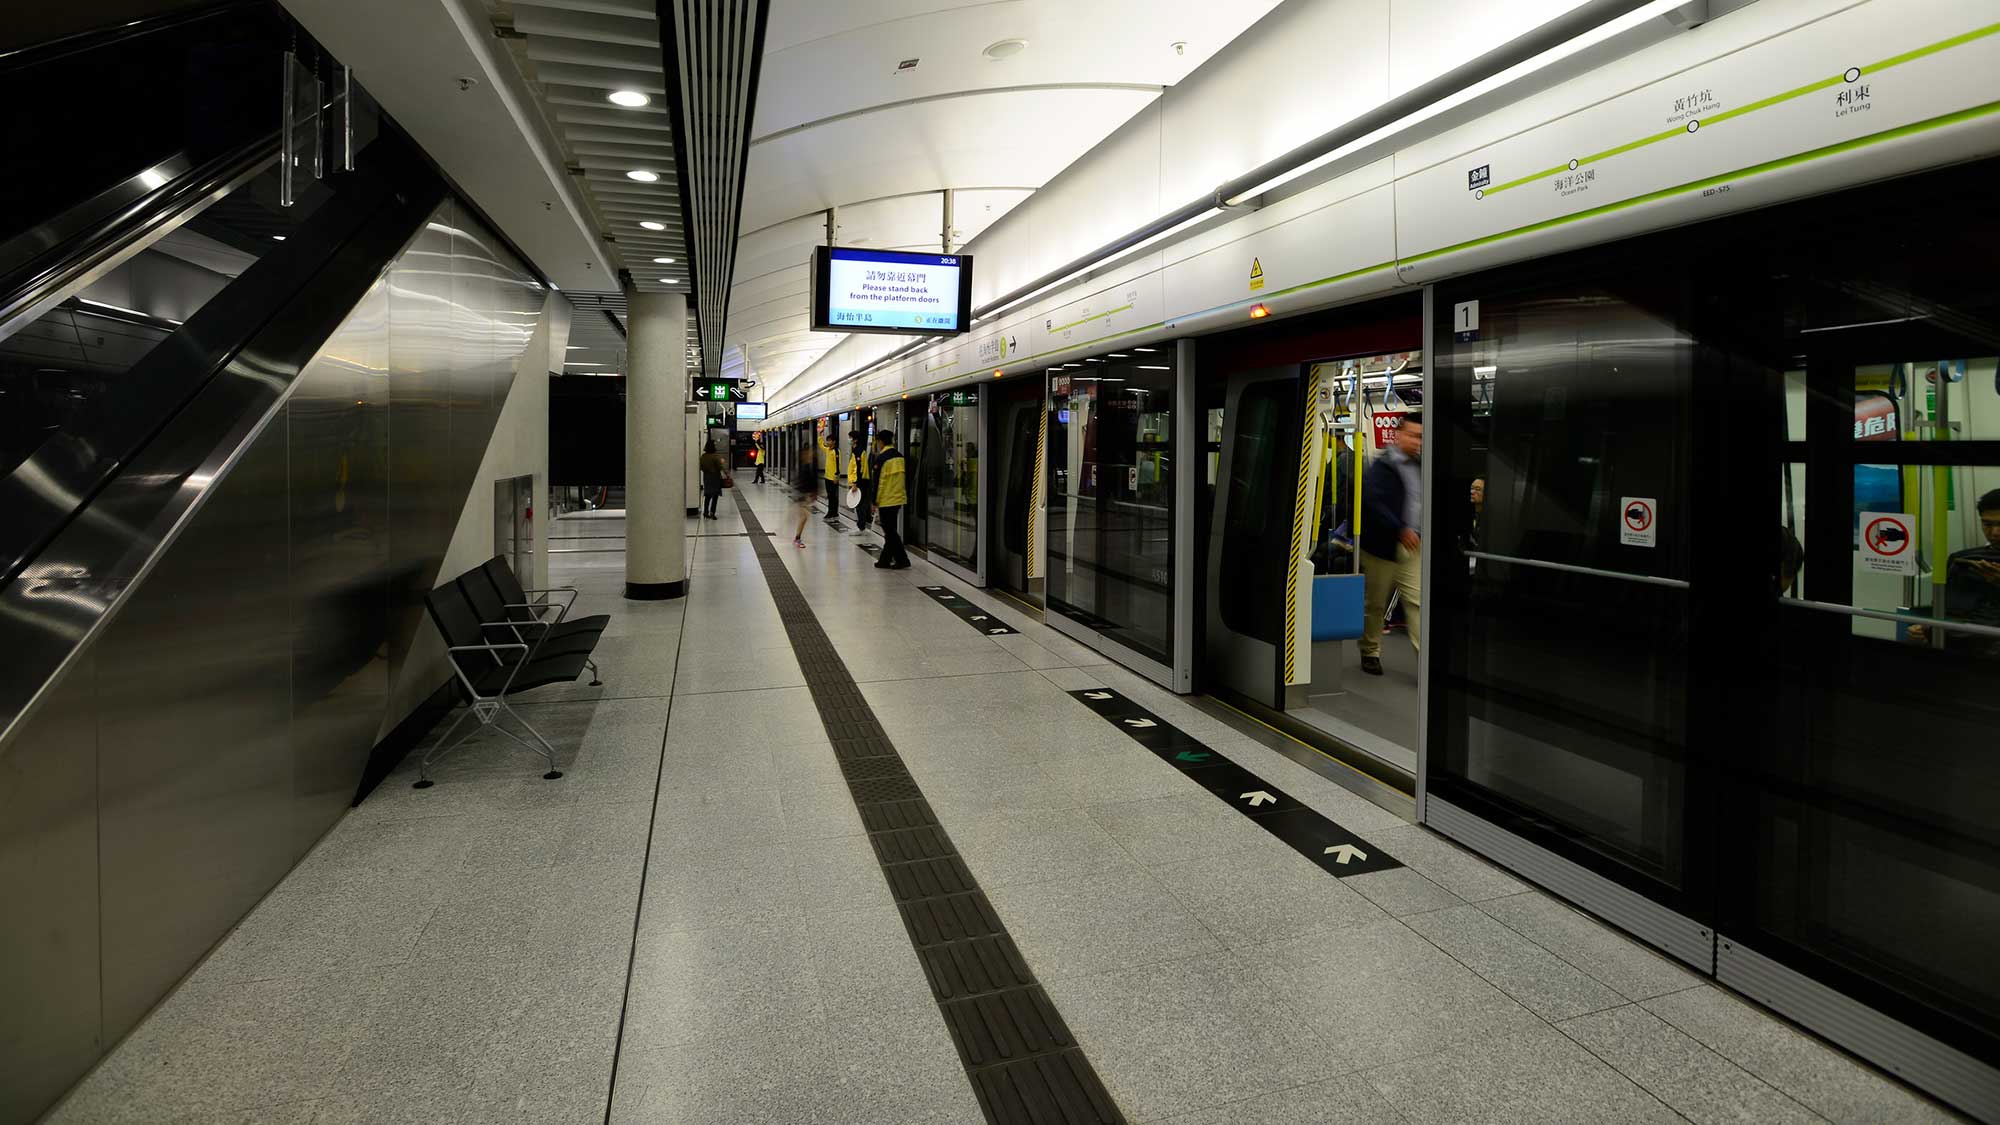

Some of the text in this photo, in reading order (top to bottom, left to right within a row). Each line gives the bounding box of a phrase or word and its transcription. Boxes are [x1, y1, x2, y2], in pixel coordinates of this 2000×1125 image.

[1673, 89, 1712, 112] 黃竹坑
[1836, 85, 1870, 107] 利東
[1666, 101, 1721, 125] Wong Chuk Hang
[1835, 101, 1871, 118] Lei Tung
[1554, 170, 1594, 191] 海洋公園
[1560, 185, 1589, 197] Ocean Park
[849, 292, 940, 303] from the platform doors
[862, 283, 928, 294] Please stand back
[1462, 306, 1469, 328] 1
[714, 385, 725, 394] 出
